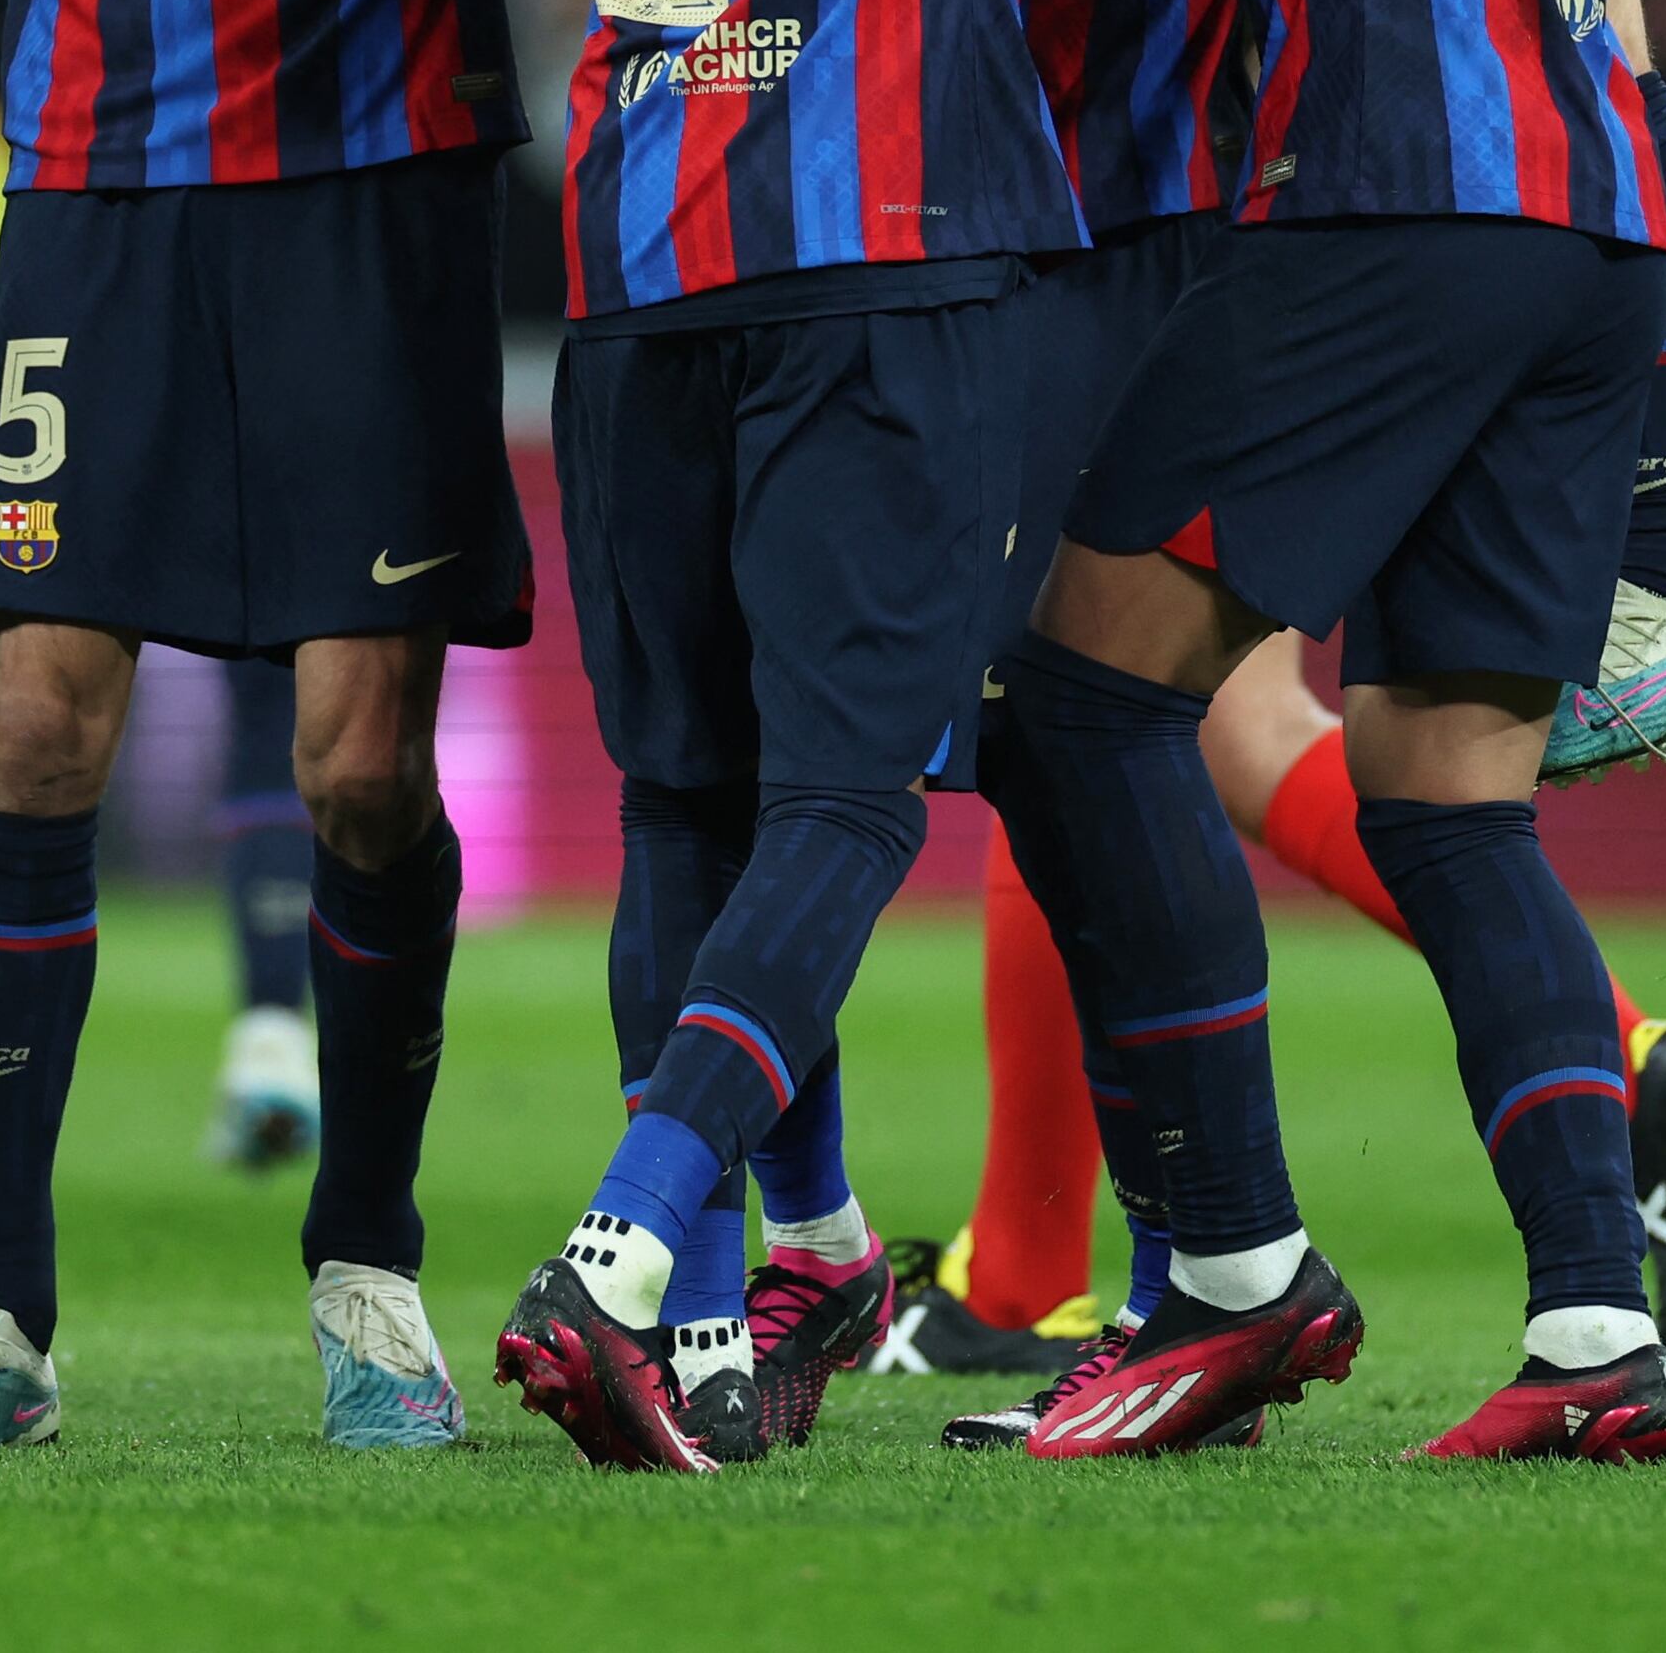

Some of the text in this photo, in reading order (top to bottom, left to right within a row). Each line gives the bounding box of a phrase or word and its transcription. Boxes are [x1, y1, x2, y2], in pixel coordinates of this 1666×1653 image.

[688, 18, 802, 51] NHCR
[669, 86, 690, 96] The
[693, 84, 709, 95] UN
[712, 82, 755, 94] Refugee
[13, 530, 38, 540] FCB
